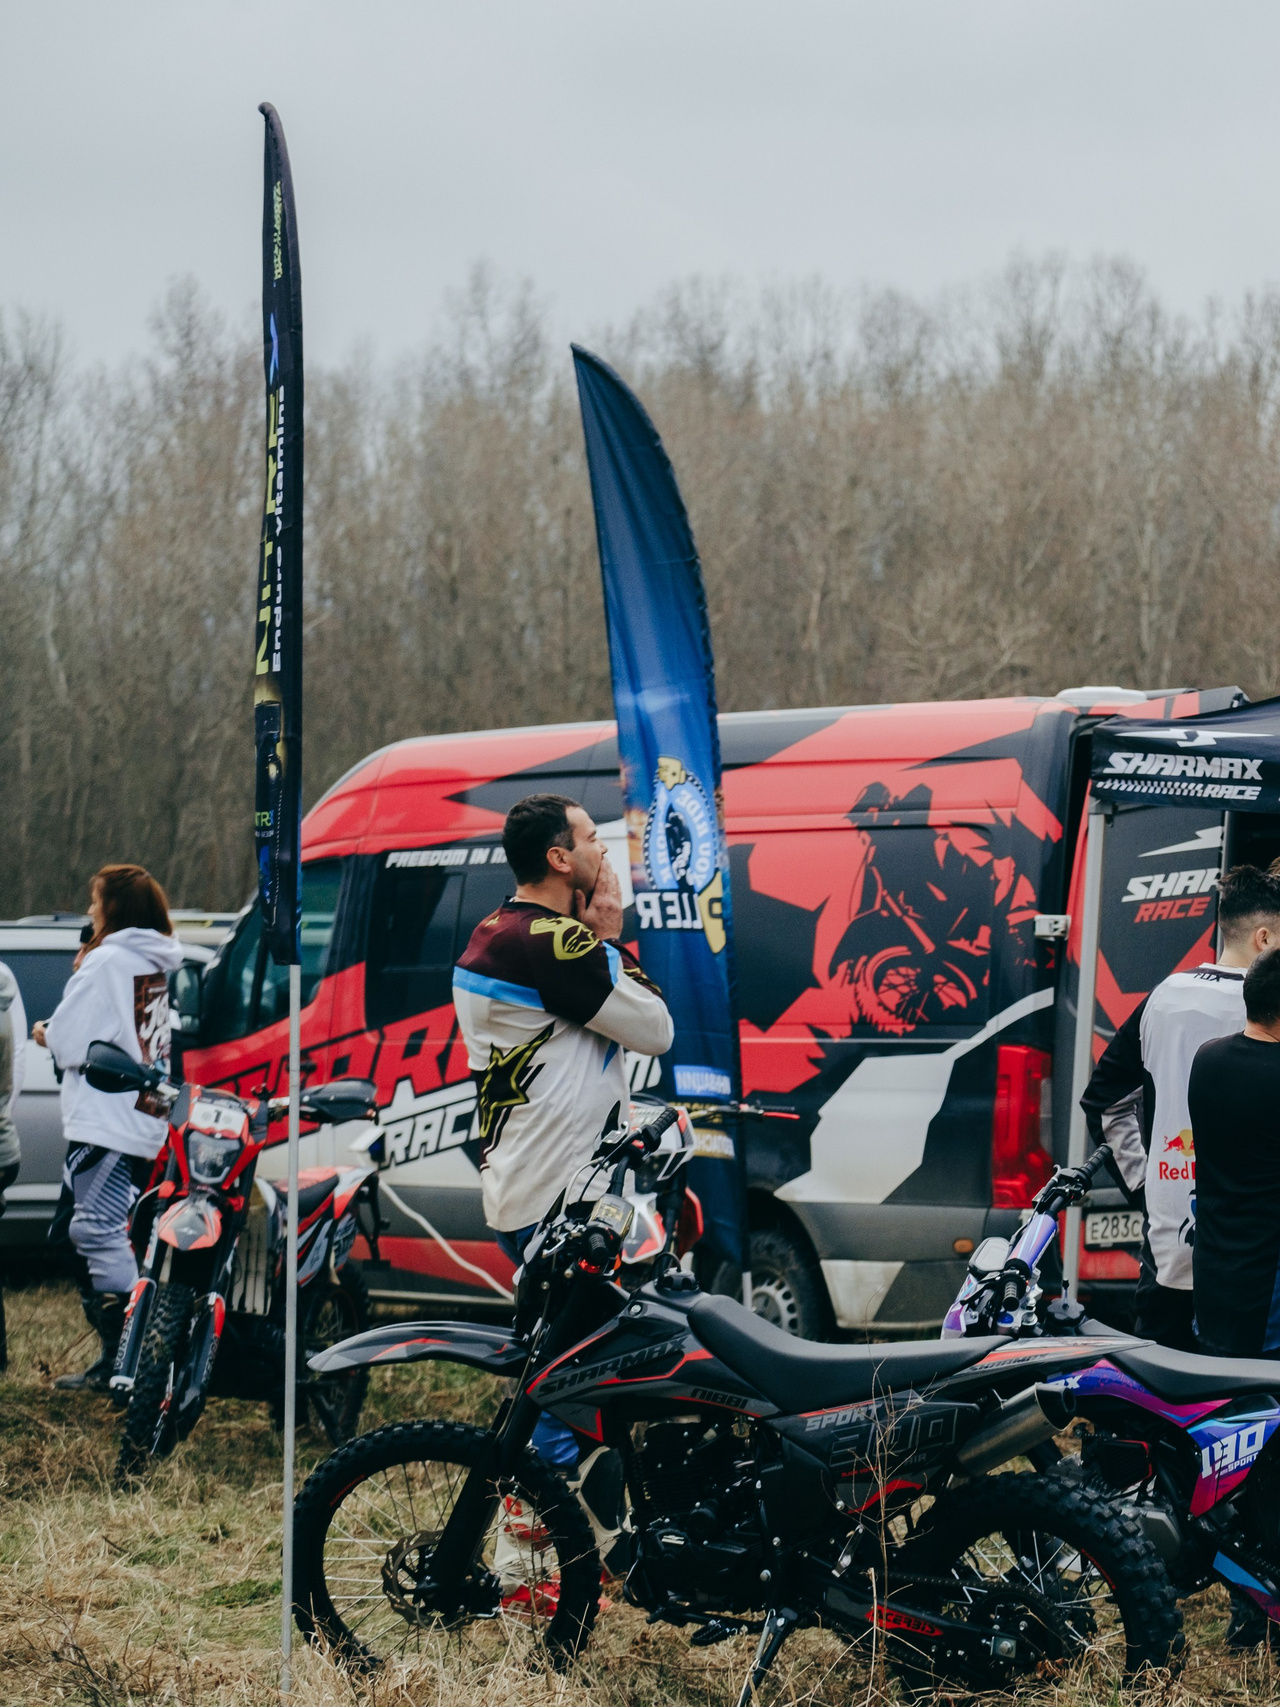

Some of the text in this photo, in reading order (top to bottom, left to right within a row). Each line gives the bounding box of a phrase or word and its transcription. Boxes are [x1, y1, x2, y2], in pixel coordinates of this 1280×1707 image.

[272, 546, 283, 673] Enduro
[1103, 752, 1263, 780] SHARMAX
[1203, 783, 1261, 800] RACE
[385, 849, 469, 868] FREEDOM
[469, 848, 490, 865] IN
[1121, 868, 1220, 902] SHAR
[1134, 897, 1211, 923] RACE
[1159, 1161, 1189, 1180] Red
[1091, 1214, 1141, 1240] E283C
[538, 1335, 688, 1398] SHARMAX
[805, 1402, 884, 1432] SPORT
[1228, 1452, 1259, 1472] SPORT
[872, 1610, 936, 1634] ACERBIS
